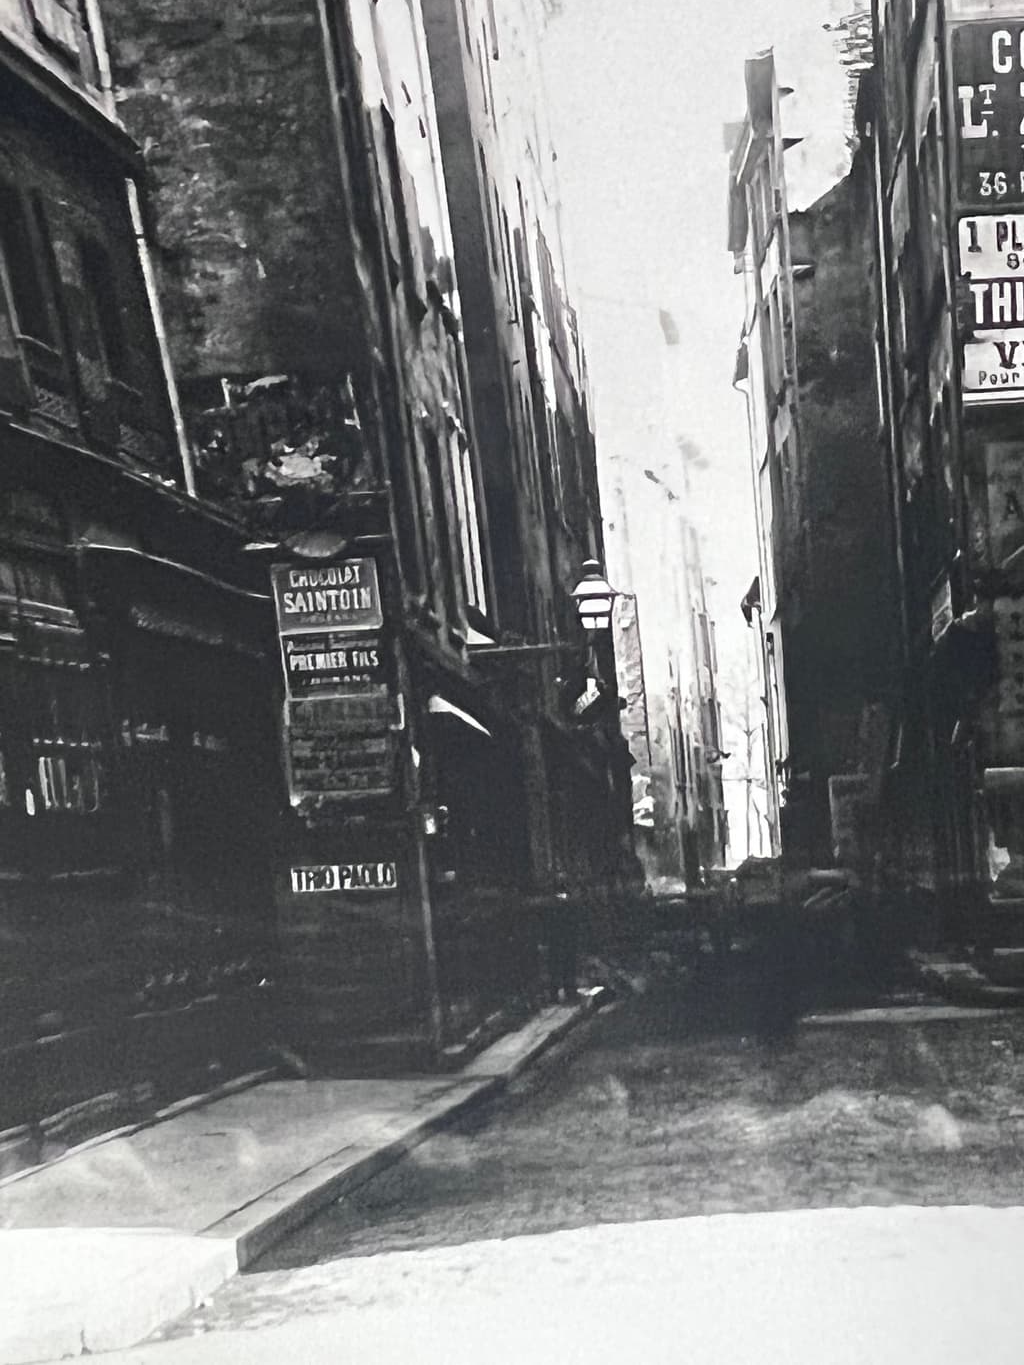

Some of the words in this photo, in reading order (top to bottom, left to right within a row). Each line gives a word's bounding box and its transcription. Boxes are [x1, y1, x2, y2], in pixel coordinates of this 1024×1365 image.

[979, 172, 1007, 195] 36
[967, 221, 982, 252] 1
[979, 370, 1020, 386] Pour
[289, 565, 360, 587] CHOCOLAT
[283, 586, 371, 613] SAINTOIN
